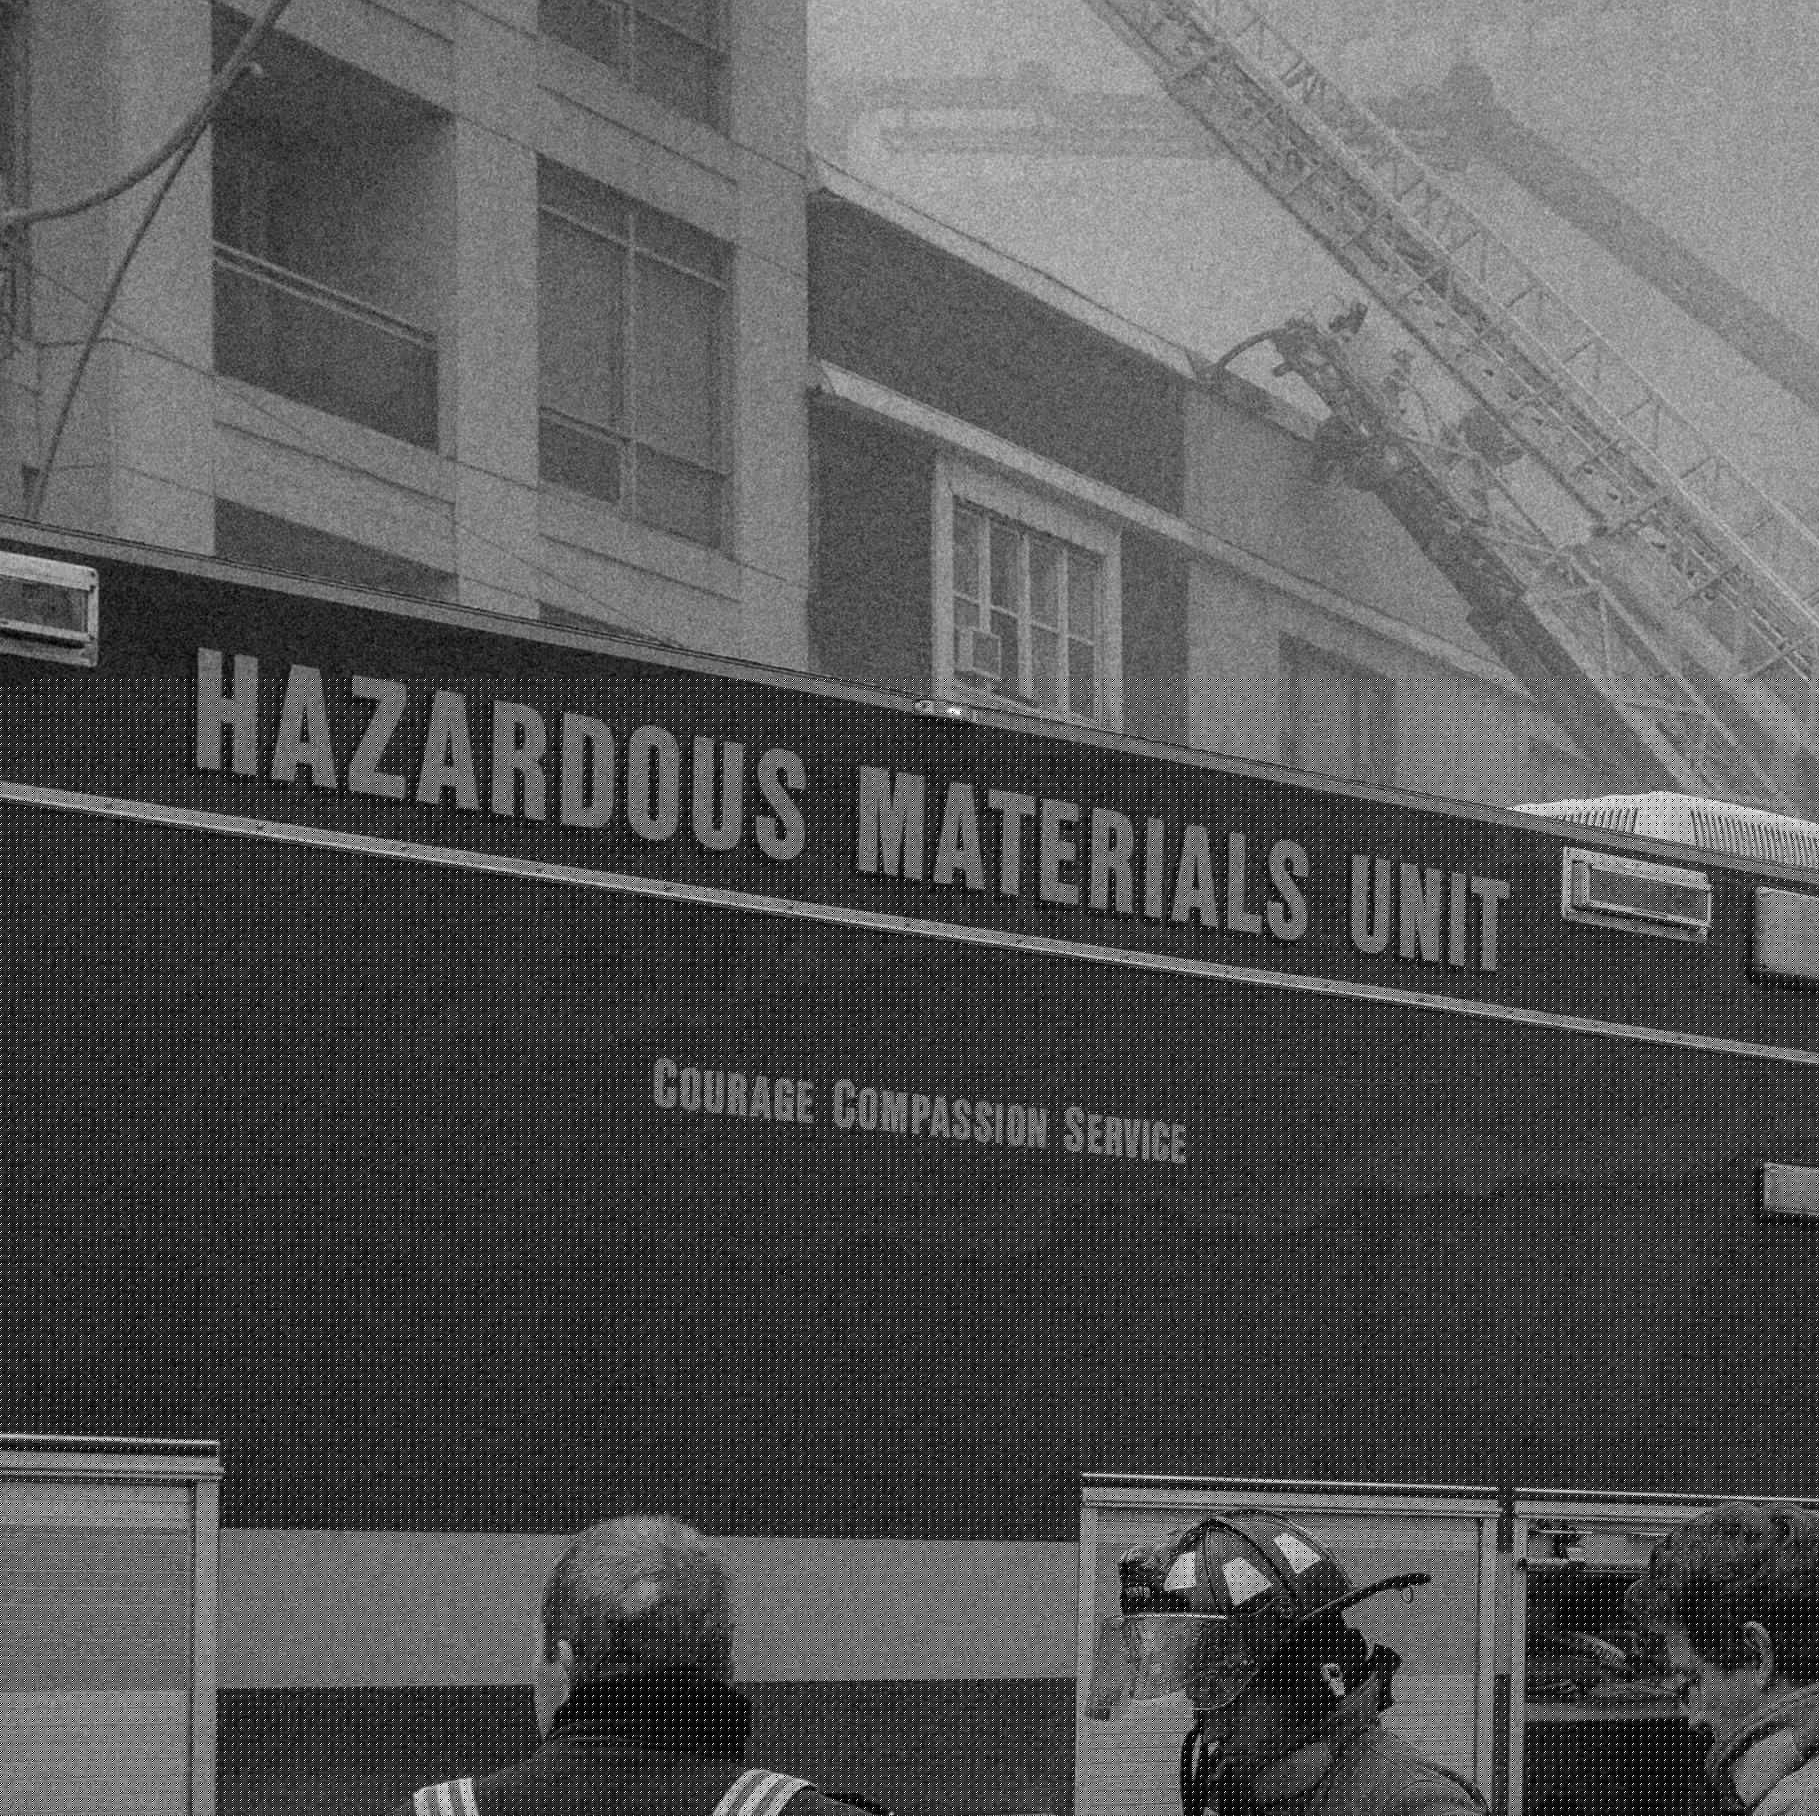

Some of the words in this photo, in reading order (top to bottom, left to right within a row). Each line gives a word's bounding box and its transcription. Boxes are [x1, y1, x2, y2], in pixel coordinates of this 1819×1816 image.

[195, 647, 807, 861] HAZARDOUS
[856, 765, 1310, 943] MATERIALS
[1349, 854, 1512, 973] UNIT
[653, 1056, 816, 1124] COURAGE
[832, 1079, 1048, 1150] COMPASSION
[1063, 1106, 1188, 1165] SERVICE
